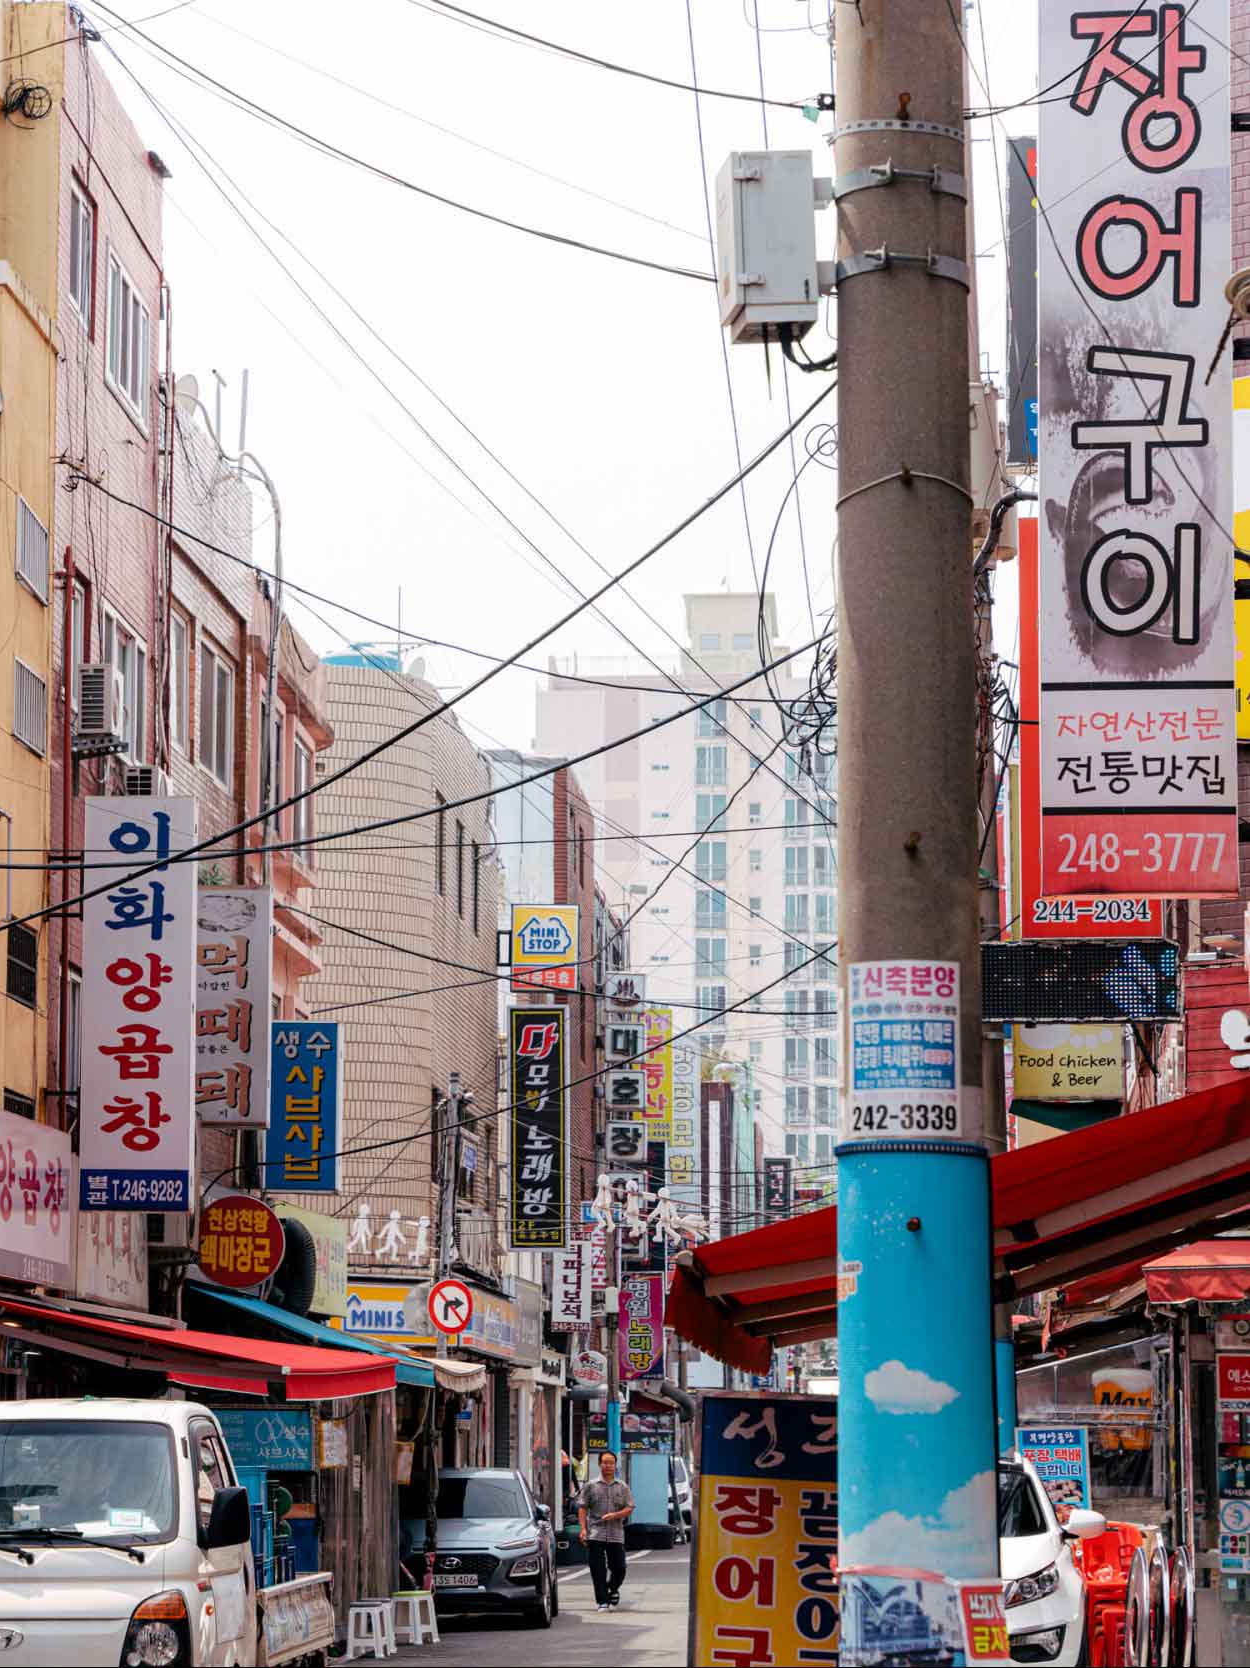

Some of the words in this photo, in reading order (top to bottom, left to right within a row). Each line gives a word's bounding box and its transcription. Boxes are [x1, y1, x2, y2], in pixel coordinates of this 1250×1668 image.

[1070, 3, 1208, 646] 장어구이
[1057, 708, 1223, 743] 자연산전문
[1057, 751, 1226, 796] 전통맛집
[1057, 832, 1226, 874] 248-3777
[1034, 900, 1150, 923] 244-2034
[528, 939, 561, 950] STOP
[530, 927, 559, 938] MINI
[863, 966, 956, 998] 신축분양
[274, 1030, 332, 1059] 생수
[1019, 1054, 1054, 1067] Food
[1059, 1055, 1117, 1068] chicken
[1068, 1073, 1102, 1086] Beer
[283, 1066, 325, 1181] 샤브샤브
[853, 1104, 957, 1131] 242-3339
[521, 1124, 554, 1216] 노래방
[1036, 1463, 1082, 1477] 능합니다
